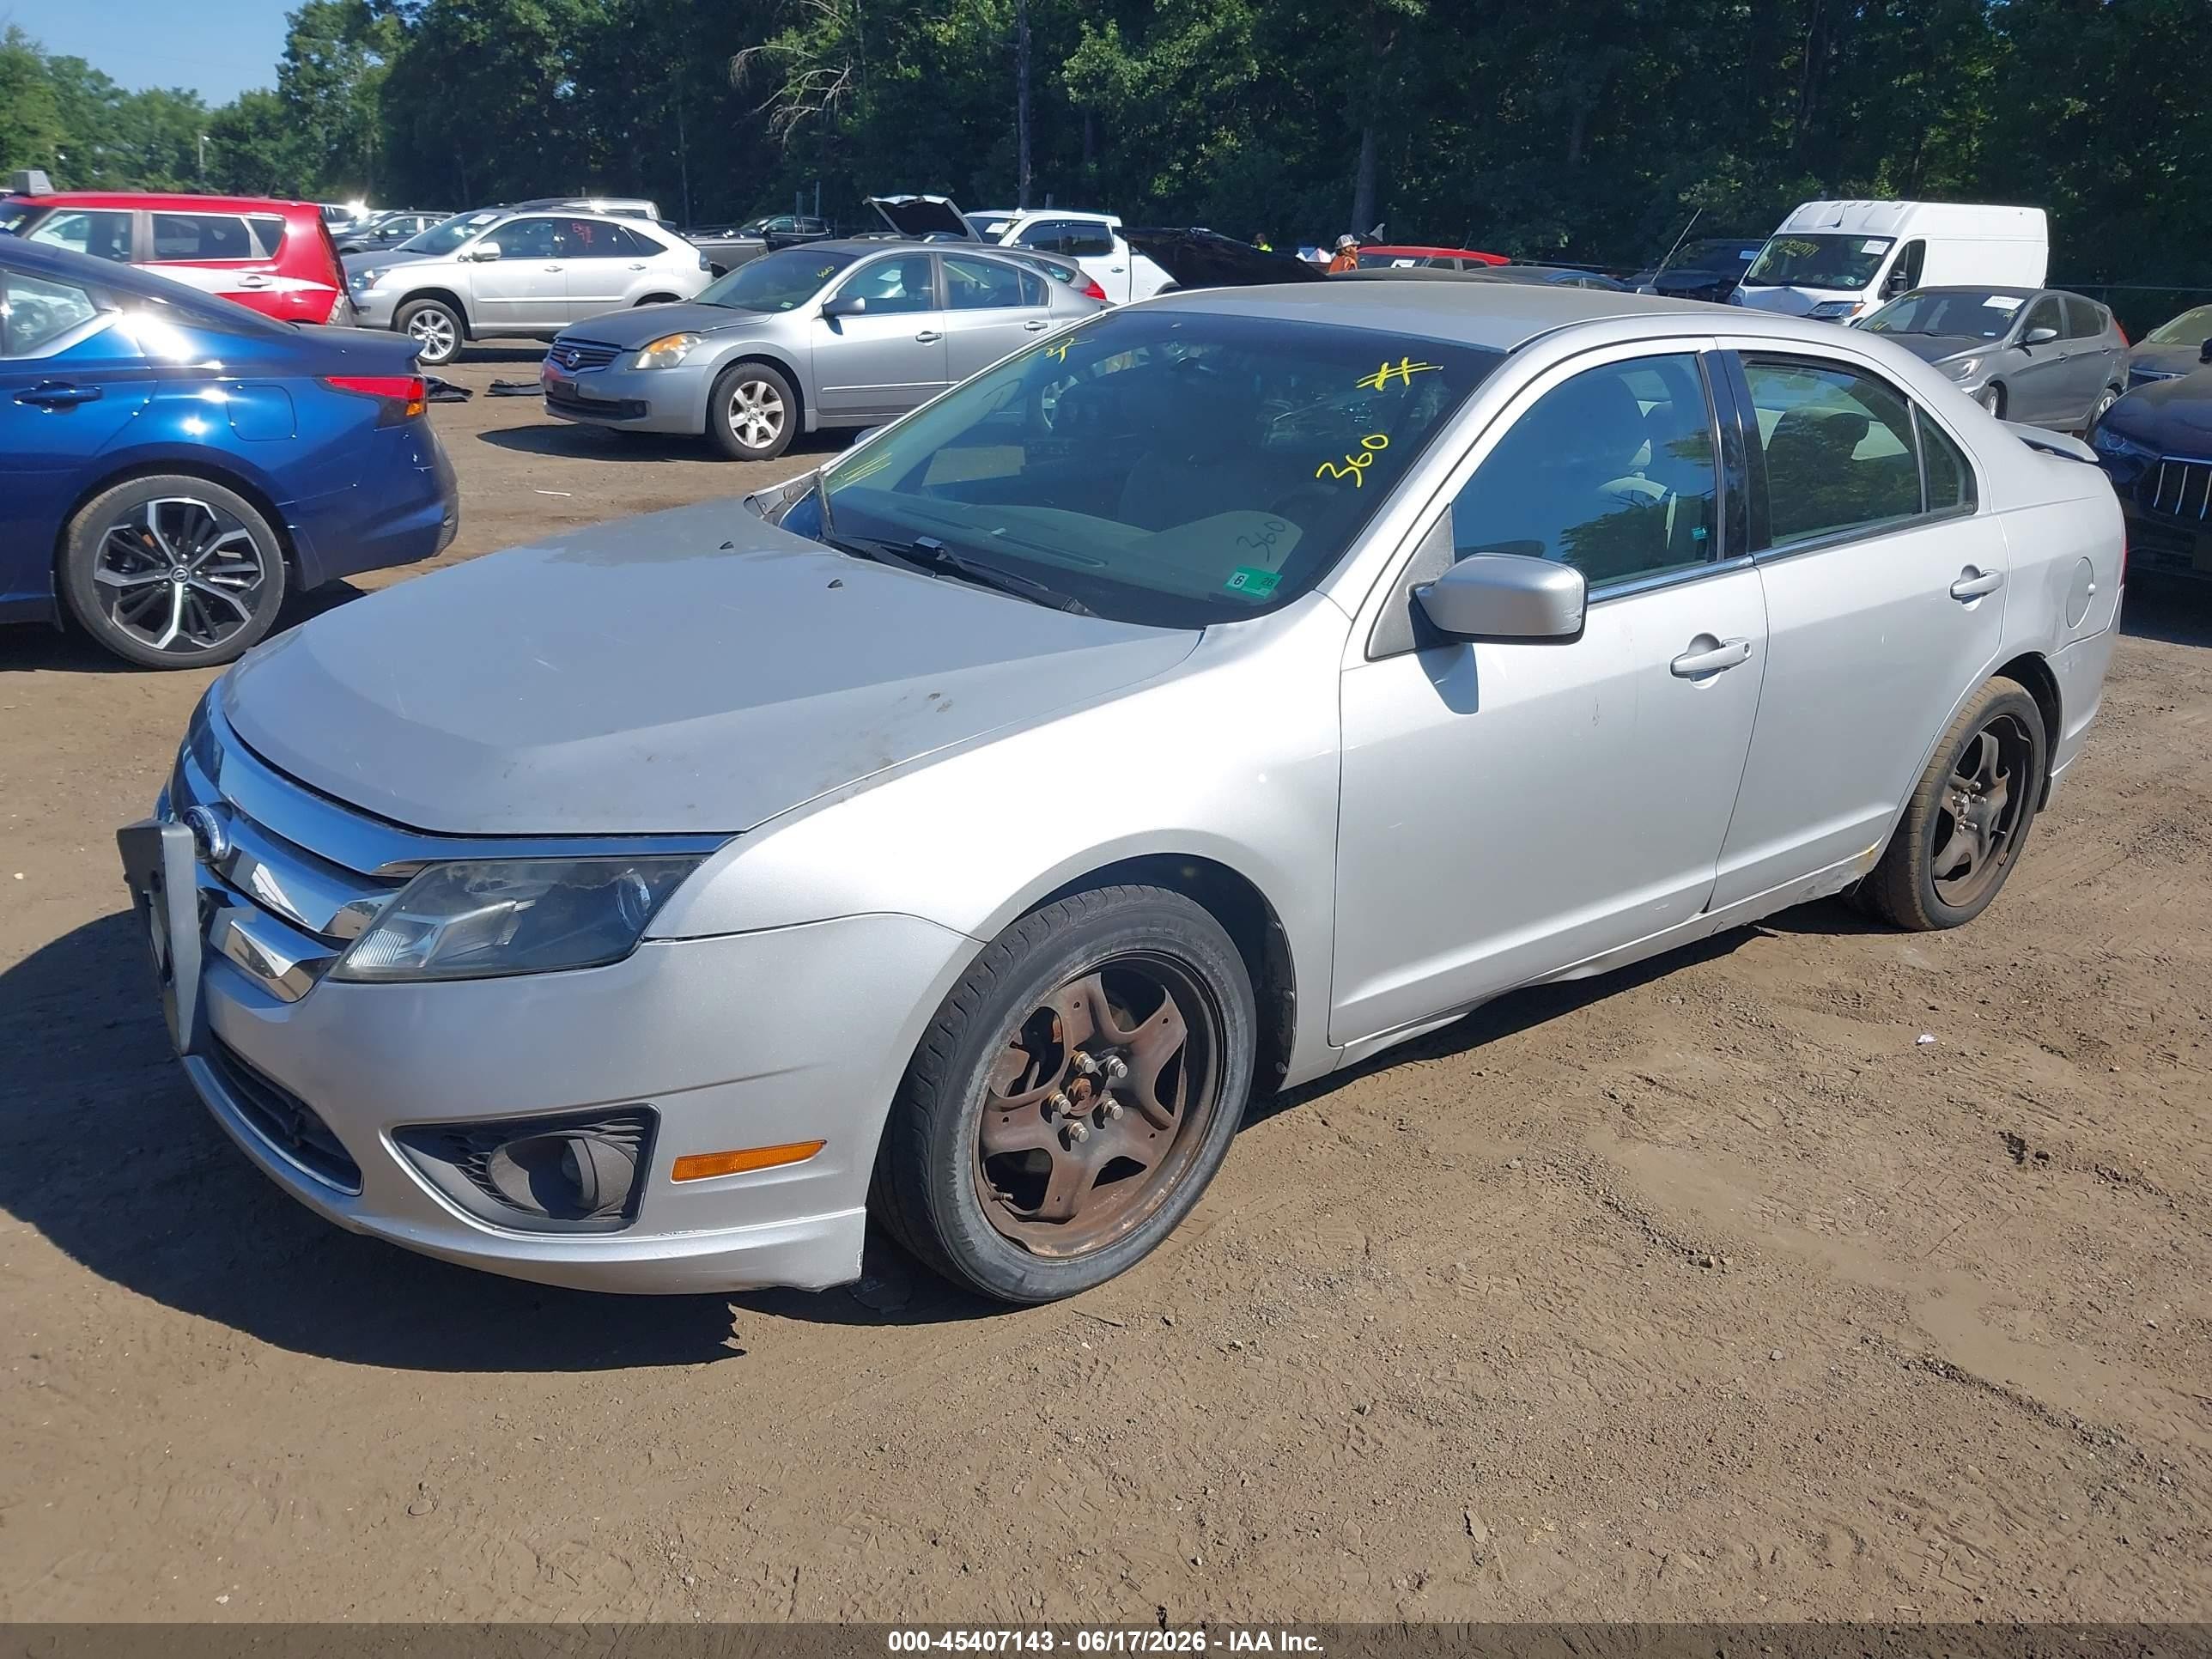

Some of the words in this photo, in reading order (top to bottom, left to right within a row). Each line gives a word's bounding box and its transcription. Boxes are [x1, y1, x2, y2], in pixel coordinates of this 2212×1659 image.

[1316, 434, 1389, 488] 360
[1236, 521, 1285, 562] 360
[1233, 575, 1244, 585] 6
